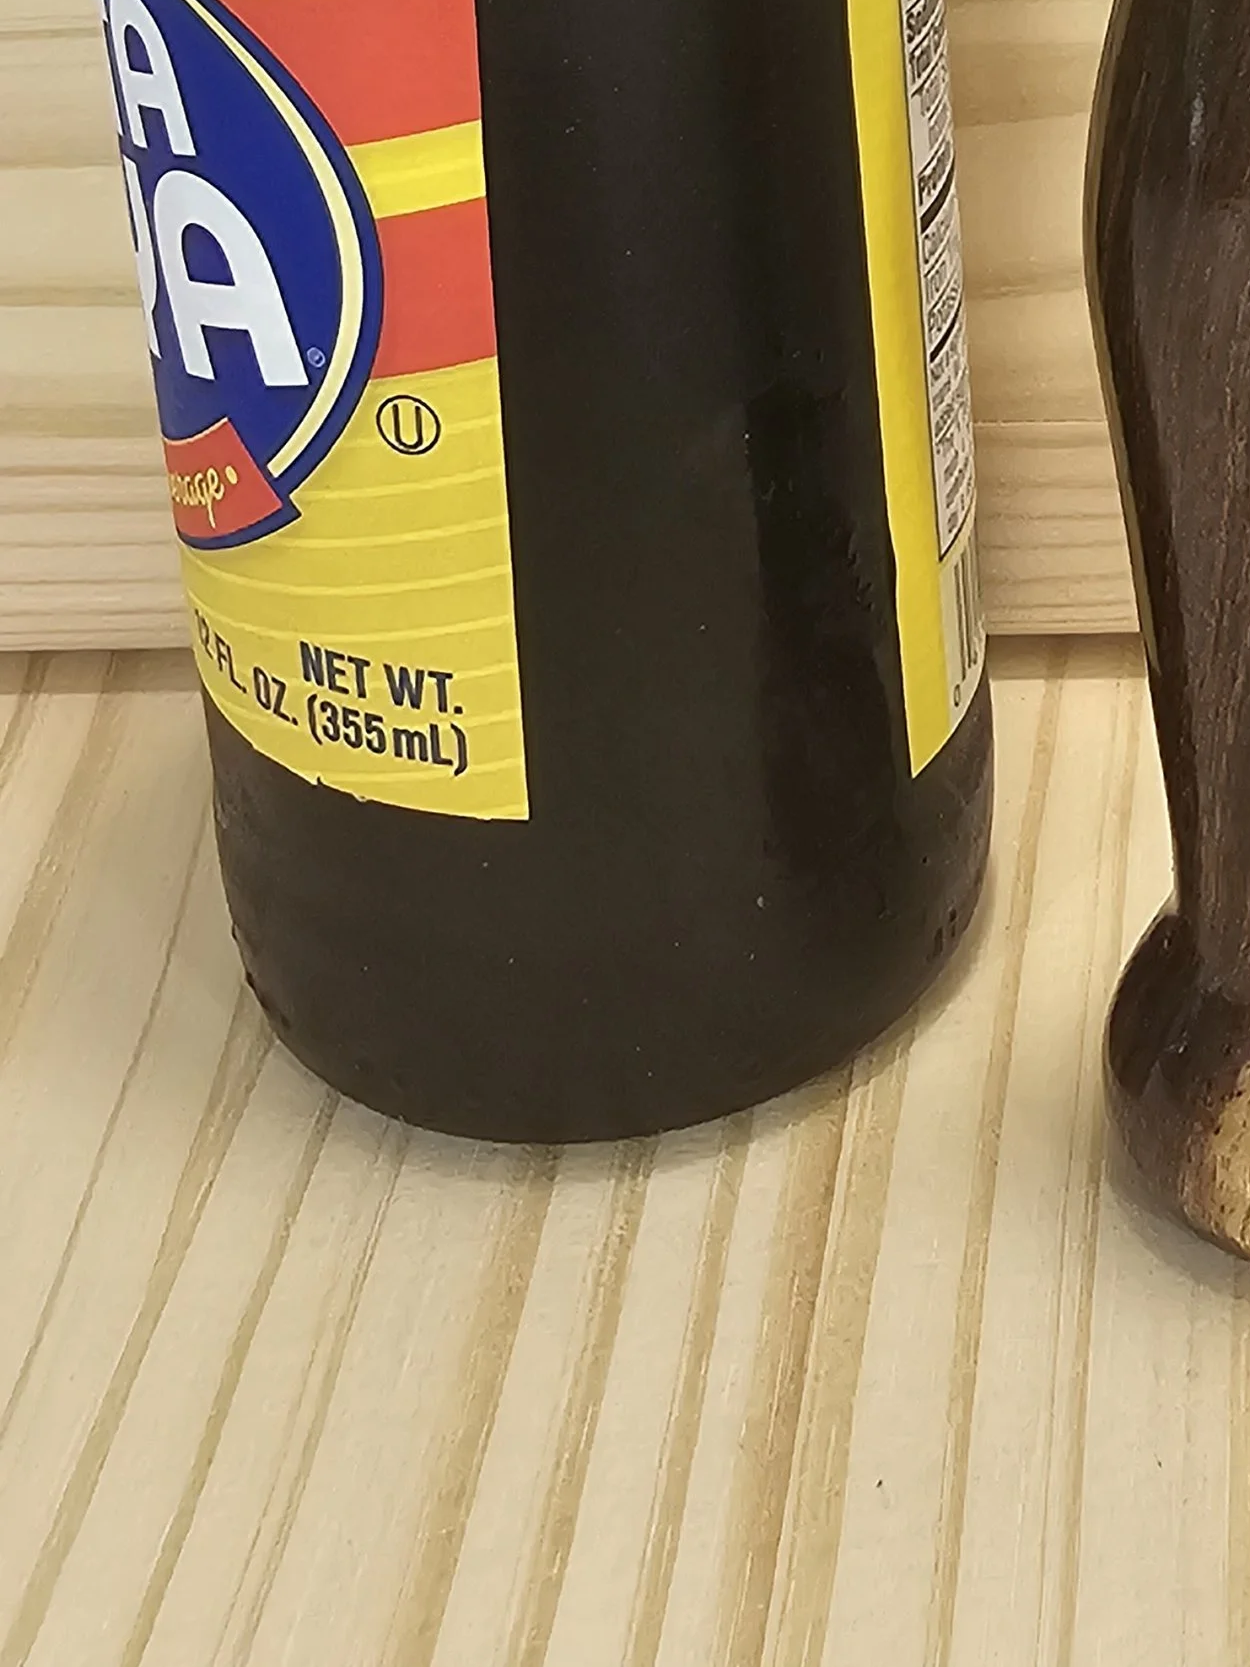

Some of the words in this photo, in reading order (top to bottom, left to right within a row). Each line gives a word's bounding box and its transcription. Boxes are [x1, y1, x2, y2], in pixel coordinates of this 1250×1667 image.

[252, 665, 299, 726] OZ.
[300, 640, 371, 699] NET
[383, 663, 464, 715] WT.
